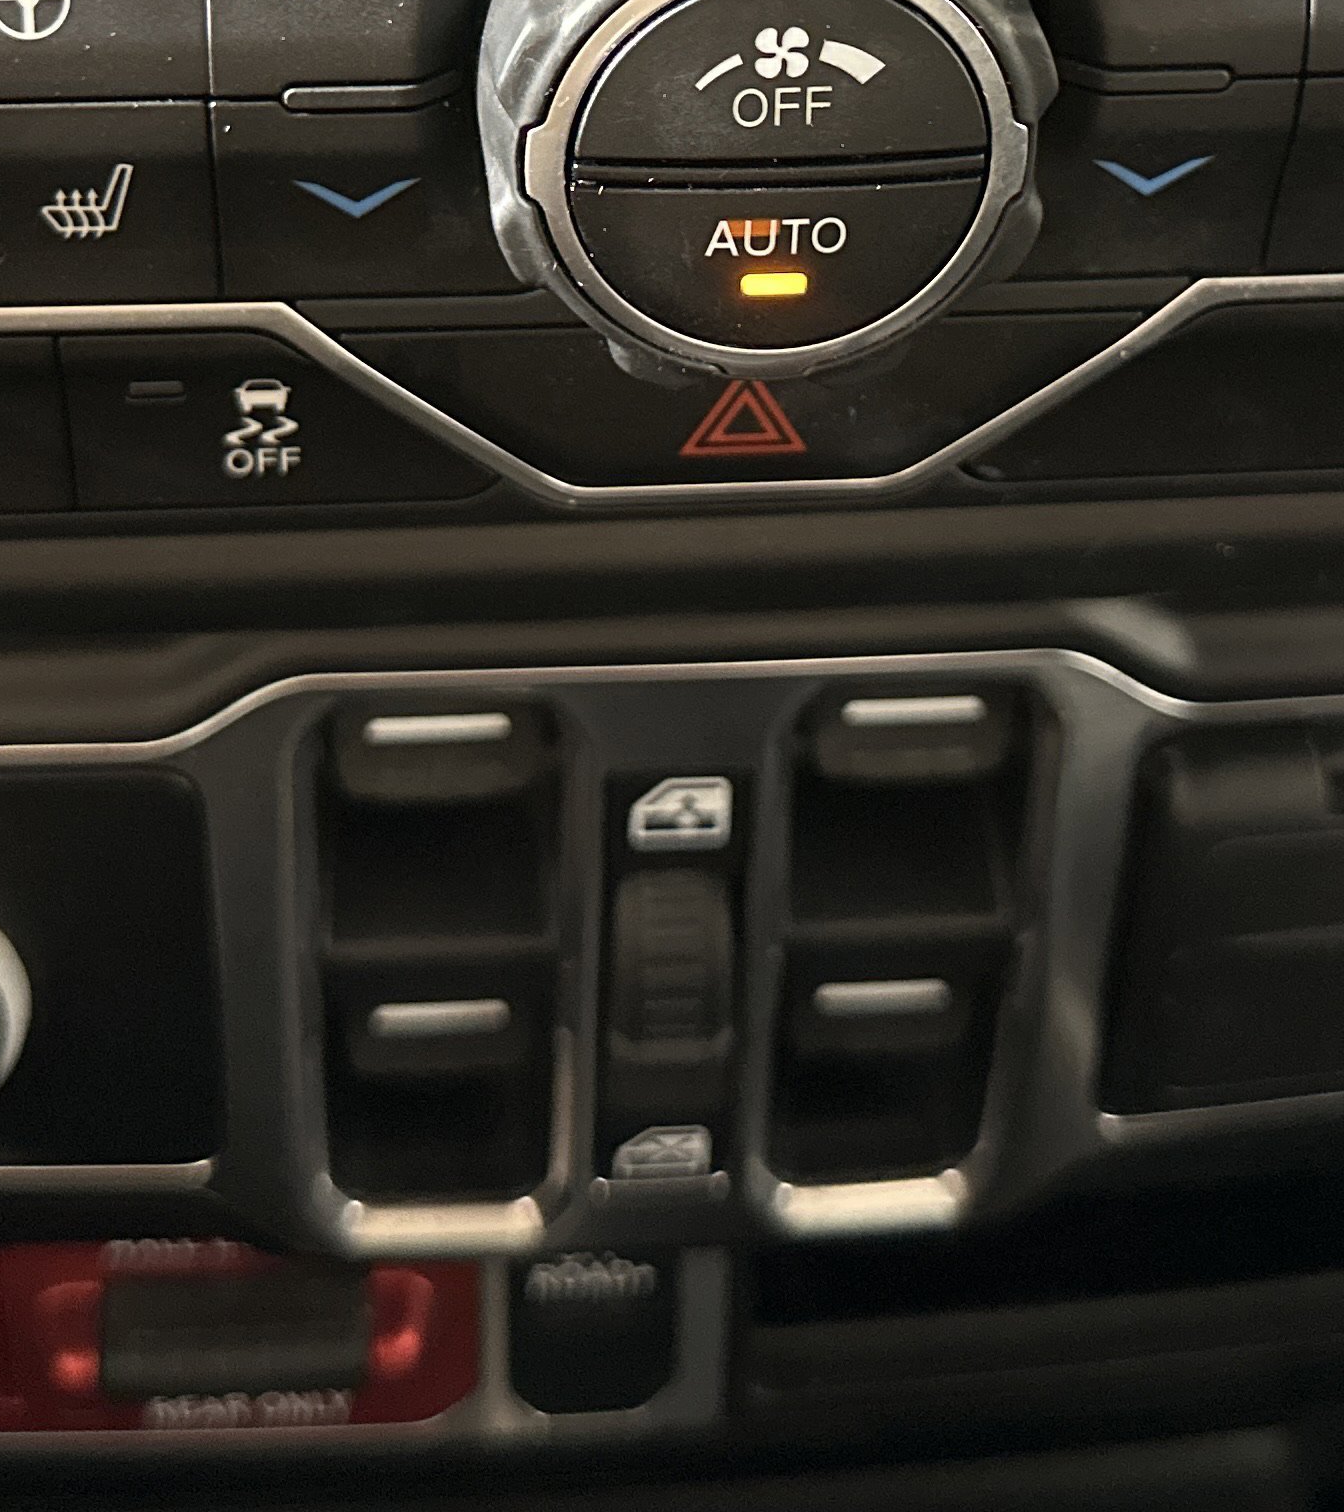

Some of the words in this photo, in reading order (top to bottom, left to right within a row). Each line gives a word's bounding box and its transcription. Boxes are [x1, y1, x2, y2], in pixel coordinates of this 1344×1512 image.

[732, 86, 832, 128] OFF
[705, 216, 847, 258] AUTO
[224, 447, 301, 478] OFF
